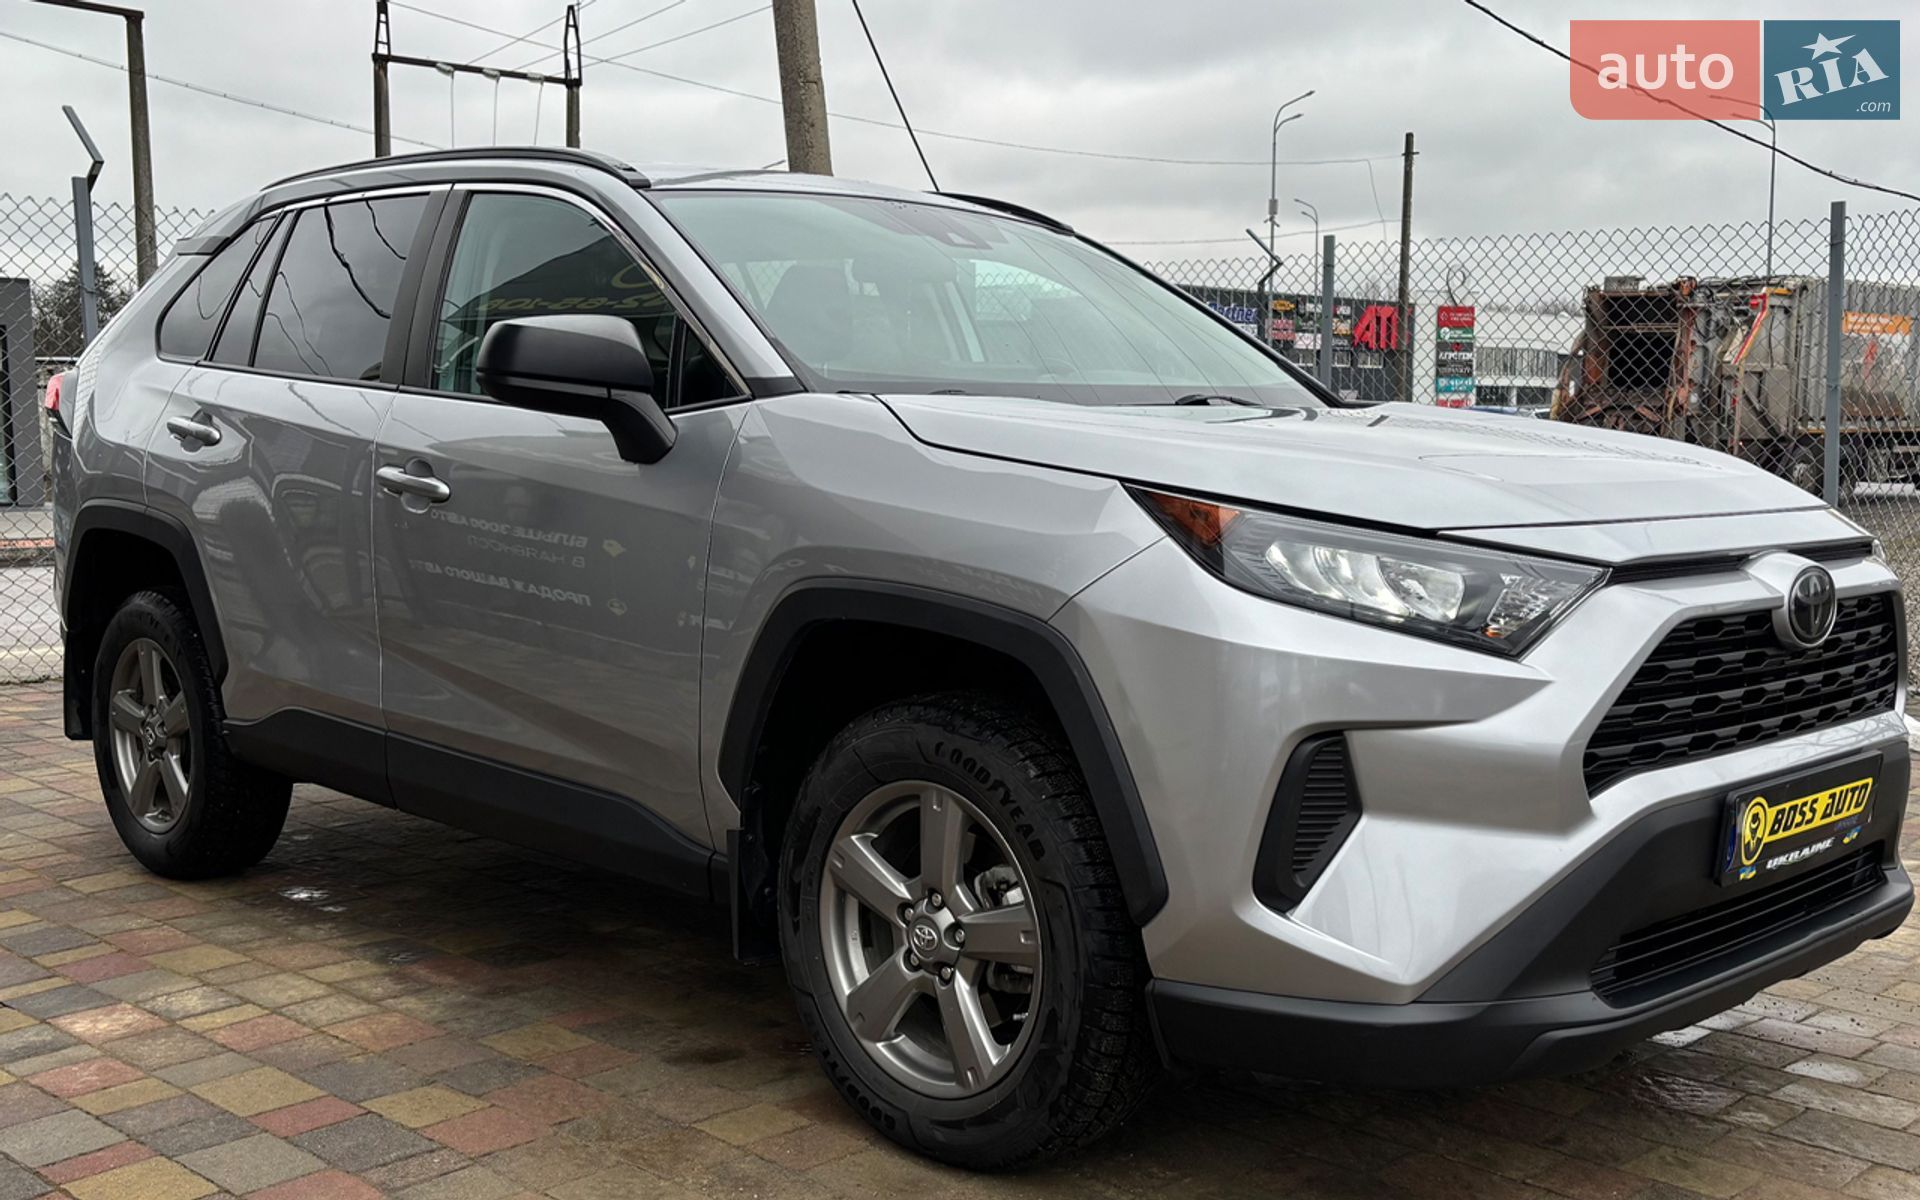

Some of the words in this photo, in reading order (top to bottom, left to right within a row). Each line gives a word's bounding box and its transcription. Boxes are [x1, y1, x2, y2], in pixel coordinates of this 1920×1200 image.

[1768, 797, 1819, 837] BOSS
[1820, 782, 1869, 822] AUTO
[1766, 836, 1836, 870] UKRAINE
